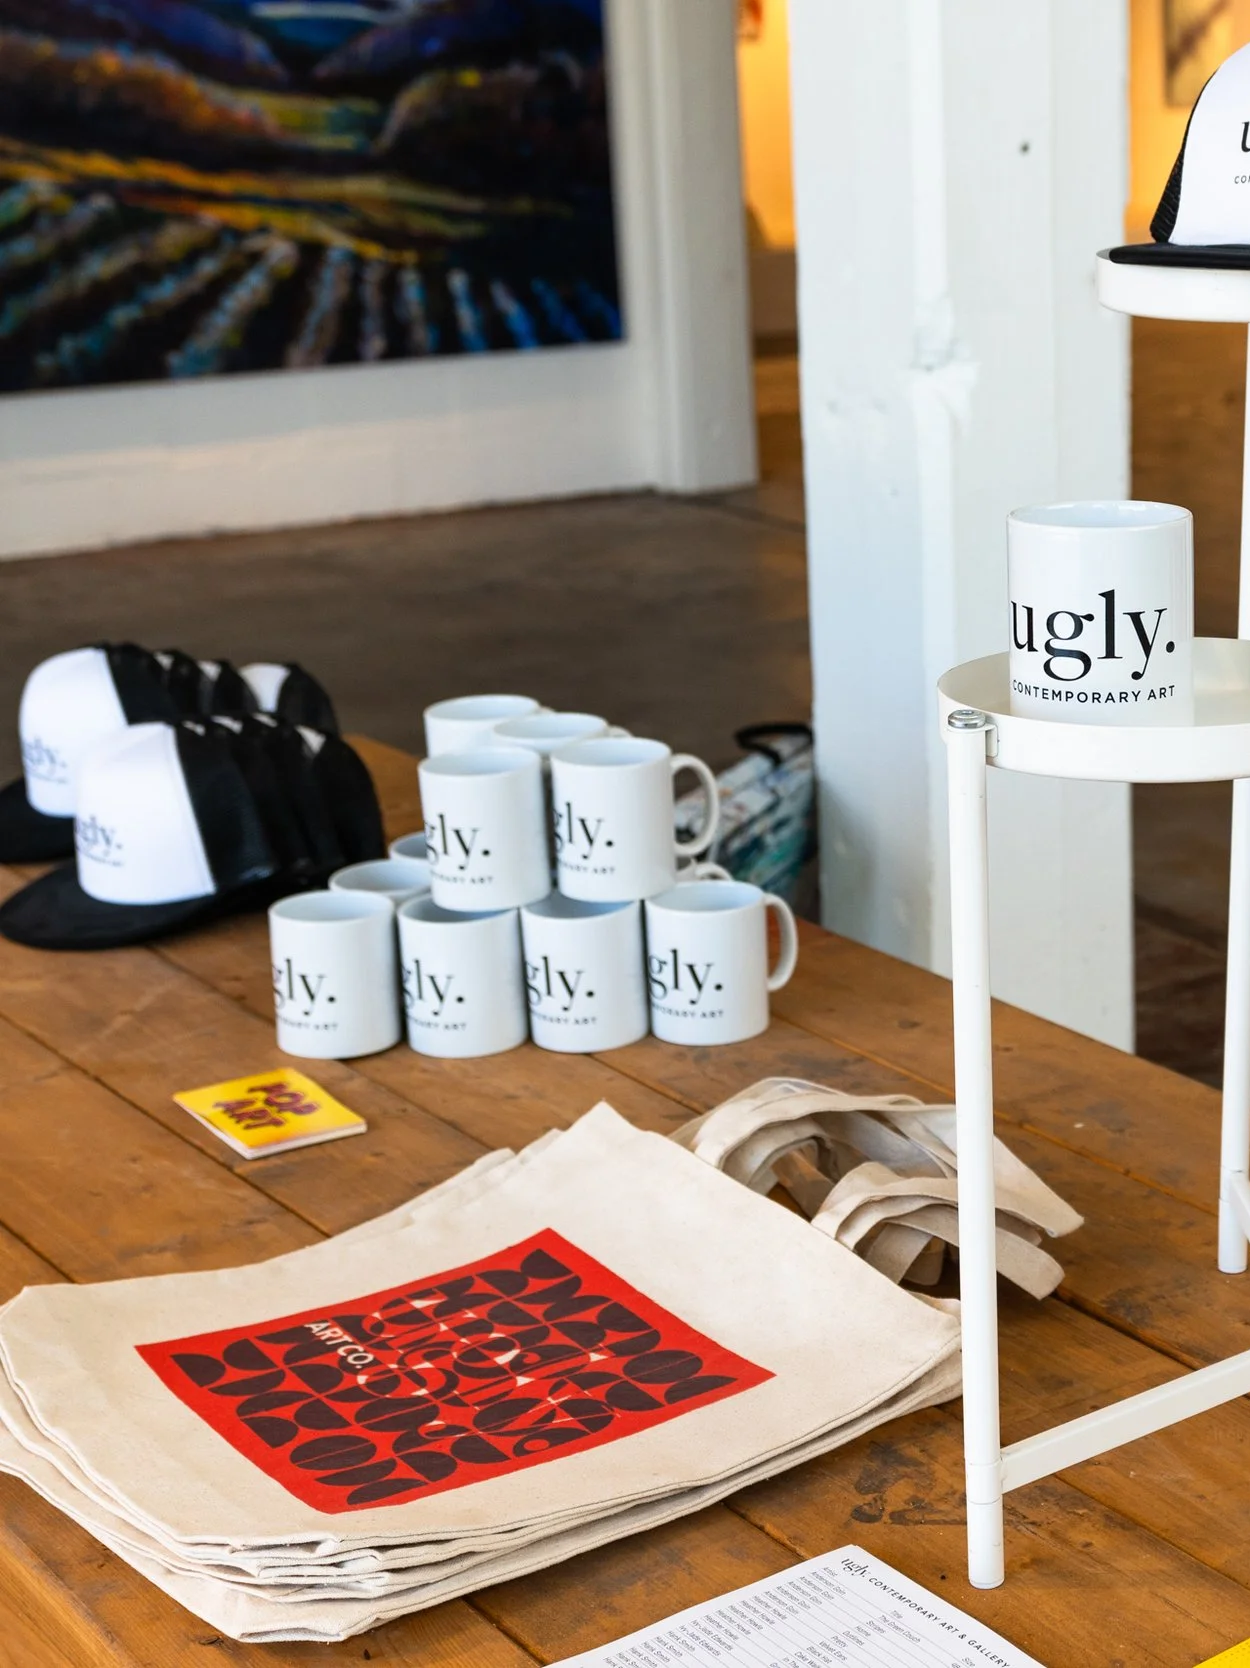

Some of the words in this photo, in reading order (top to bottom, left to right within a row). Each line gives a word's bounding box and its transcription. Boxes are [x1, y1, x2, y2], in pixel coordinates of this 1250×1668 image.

[1010, 589, 1175, 682] ugly.
[1013, 680, 1141, 703] CONTEMPORARY
[1148, 685, 1175, 700] ART
[424, 814, 490, 871] gly.
[553, 802, 613, 860] ly.
[271, 957, 337, 1016] ly.
[402, 958, 464, 1016] ly.
[524, 956, 595, 1012] gly.
[648, 948, 723, 1005] gly.
[304, 1320, 353, 1348] ART
[337, 1344, 374, 1369] CO.
[841, 1558, 871, 1577] ugly.
[868, 1577, 940, 1621] CONTEMPORARY
[938, 1622, 959, 1633] ART
[968, 1640, 1010, 1668] GALLERY
